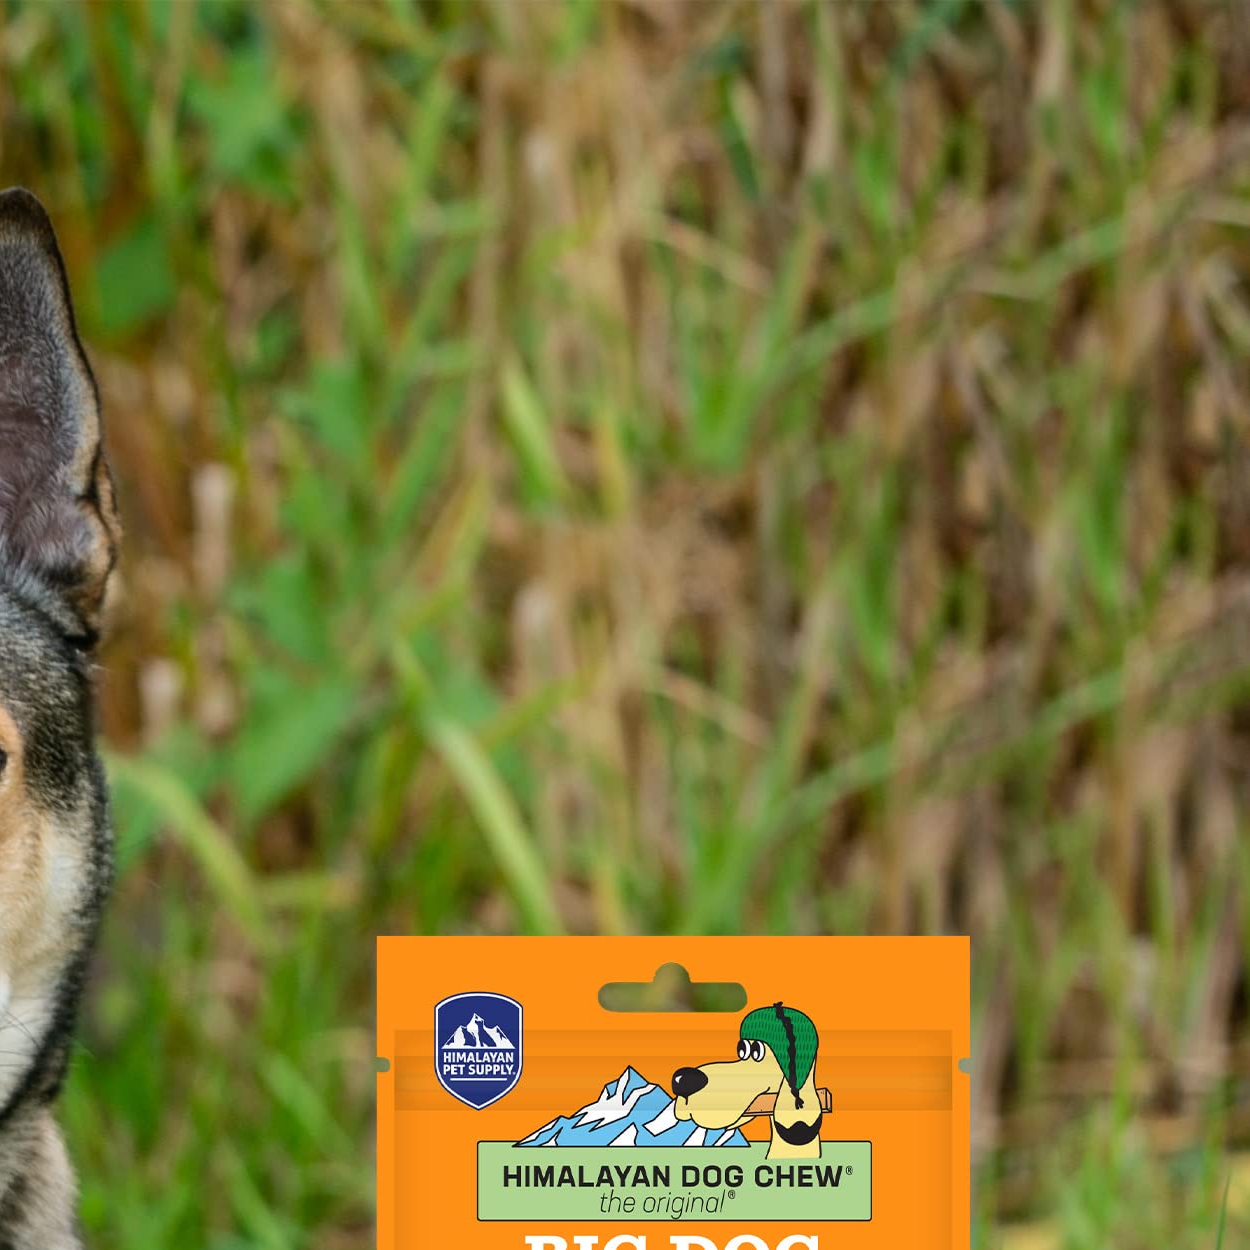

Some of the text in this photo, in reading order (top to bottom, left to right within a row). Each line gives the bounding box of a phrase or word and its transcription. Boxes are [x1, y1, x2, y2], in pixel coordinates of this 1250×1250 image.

[443, 1052, 514, 1063] HIMALAYAN
[443, 1064, 465, 1075] PET
[503, 1165, 670, 1188] HIMALAYAN
[681, 1164, 744, 1188] DOG
[600, 1189, 636, 1213] the
